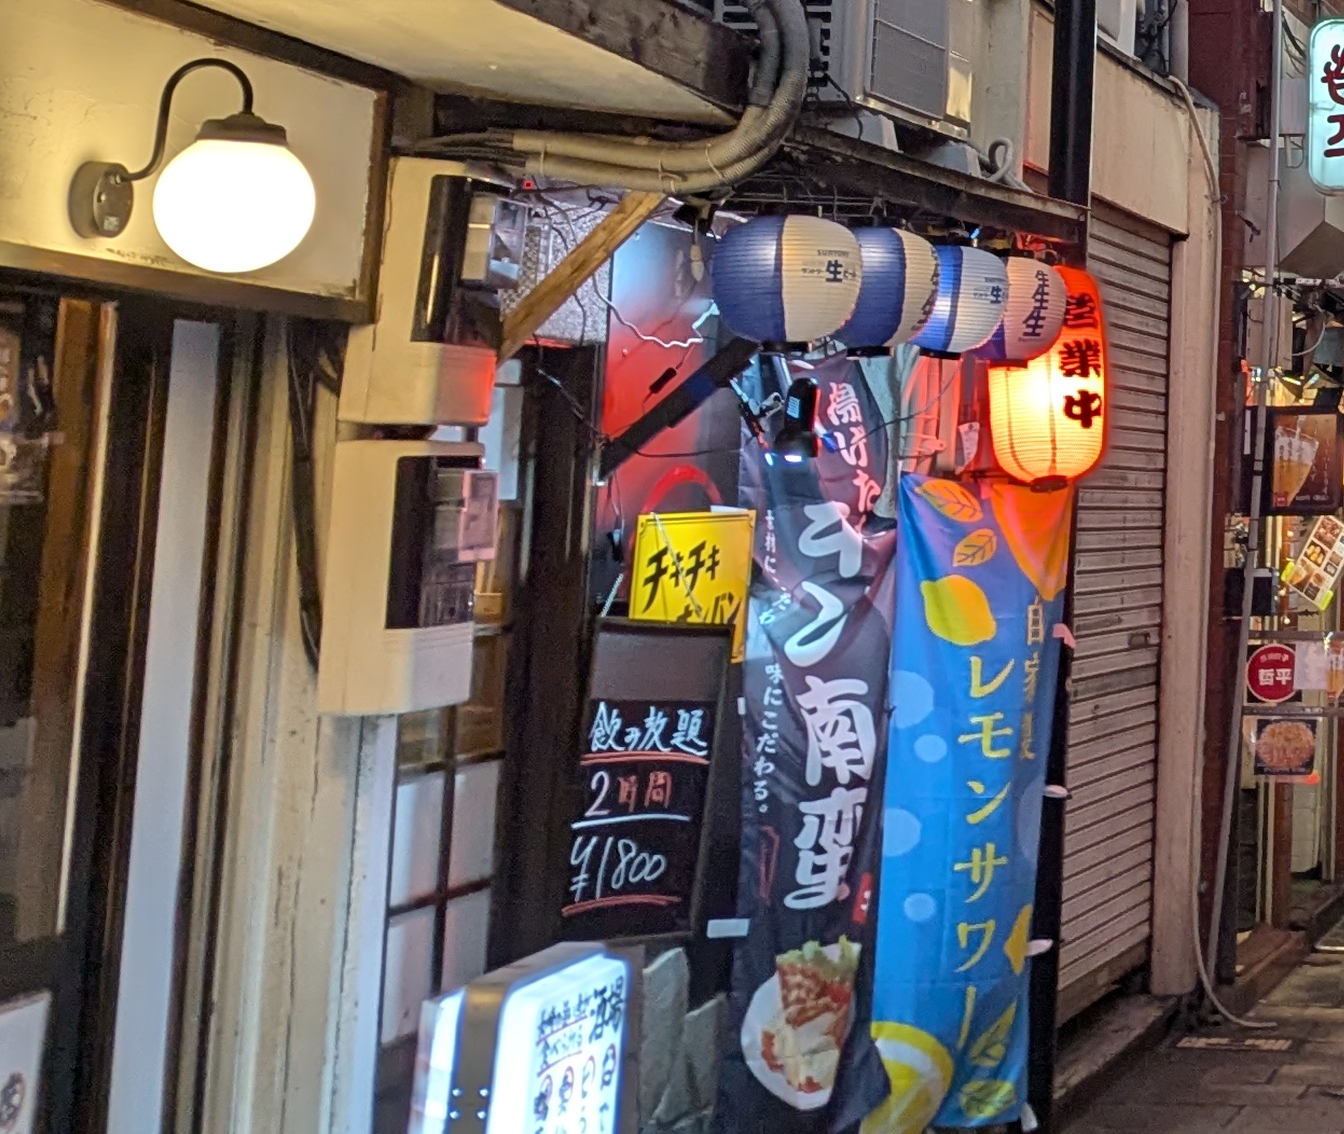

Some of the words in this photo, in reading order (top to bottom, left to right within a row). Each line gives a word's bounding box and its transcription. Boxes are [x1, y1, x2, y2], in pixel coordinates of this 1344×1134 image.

[1056, 292, 1102, 429] 営業中
[826, 381, 883, 534] 揚げた
[642, 540, 721, 614] チキチキ
[589, 702, 709, 756] 飲み放題
[584, 770, 673, 817] 2時間
[569, 836, 666, 903] ¥1800
[954, 656, 1016, 1051] レモンサワー
